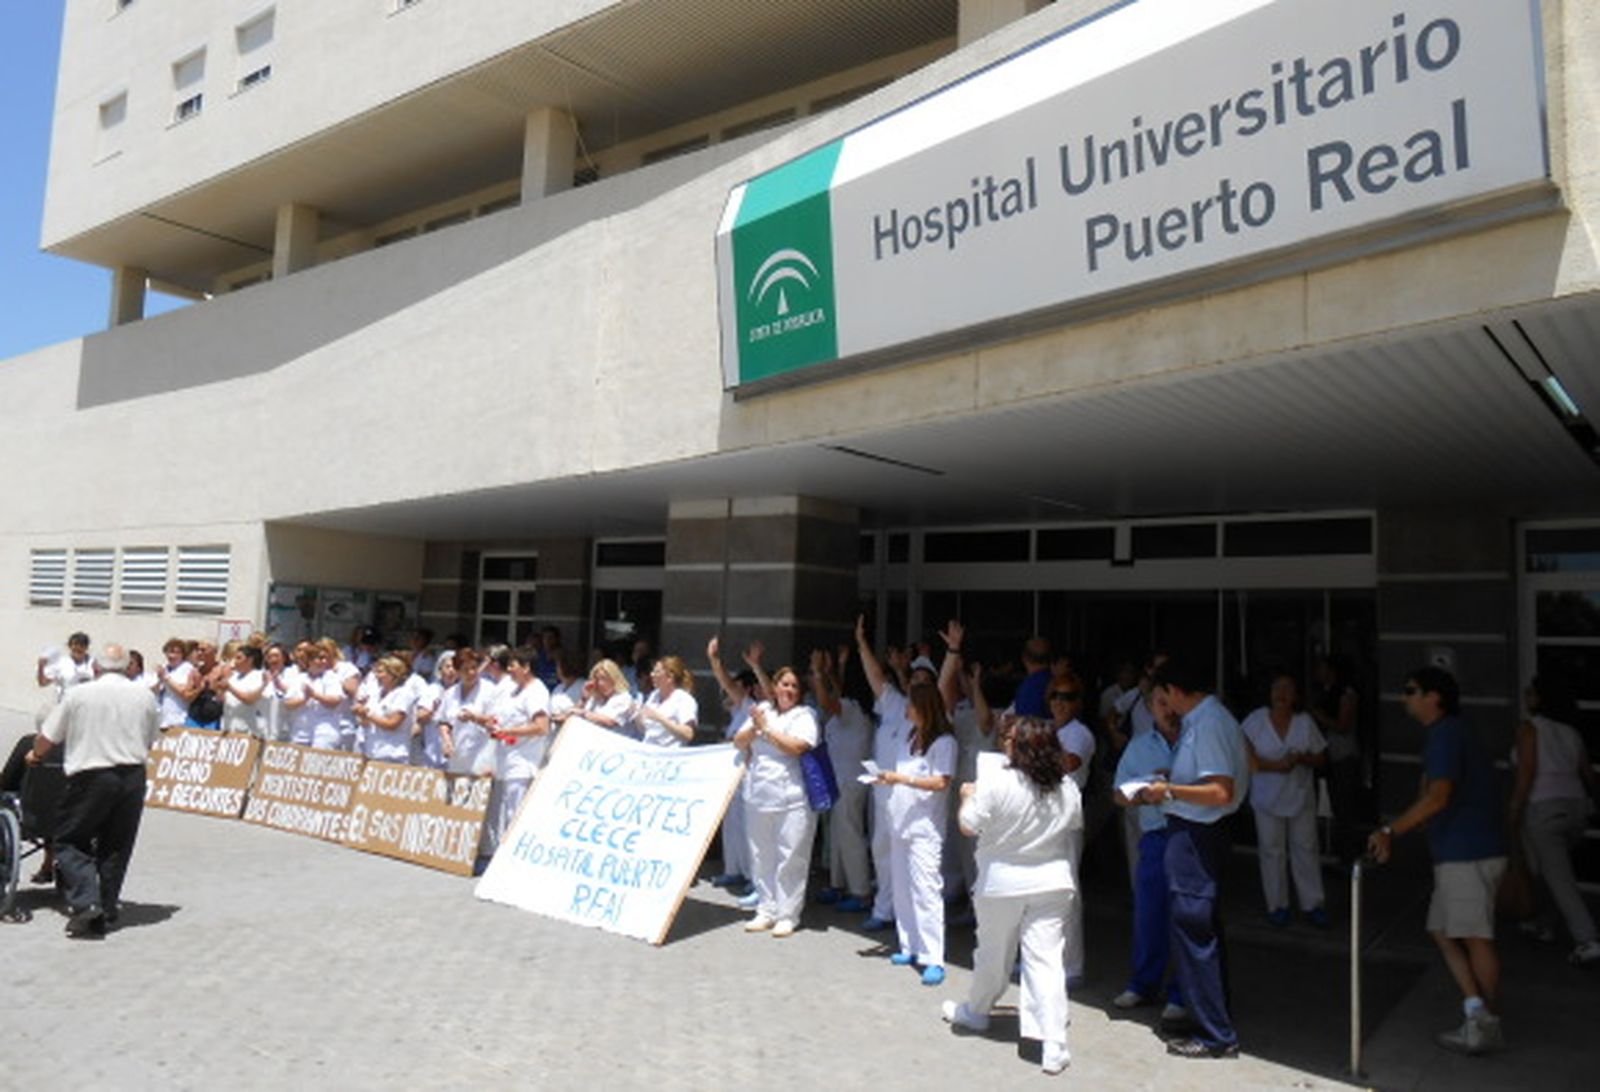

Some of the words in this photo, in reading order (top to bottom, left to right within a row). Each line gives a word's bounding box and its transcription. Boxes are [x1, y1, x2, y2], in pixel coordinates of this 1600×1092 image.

[873, 156, 1038, 260] Hospital
[1059, 13, 1461, 196] Universitario
[1085, 179, 1276, 272] Puerto
[1306, 99, 1471, 211] Real
[156, 757, 212, 783] DIGNO
[579, 750, 625, 776] NO
[169, 783, 244, 816] RECORTES
[359, 765, 378, 794] SI
[378, 768, 434, 803] CLECE
[556, 780, 705, 836] RECORTES
[560, 818, 641, 853] CLECE
[598, 853, 672, 889] PUERTO
